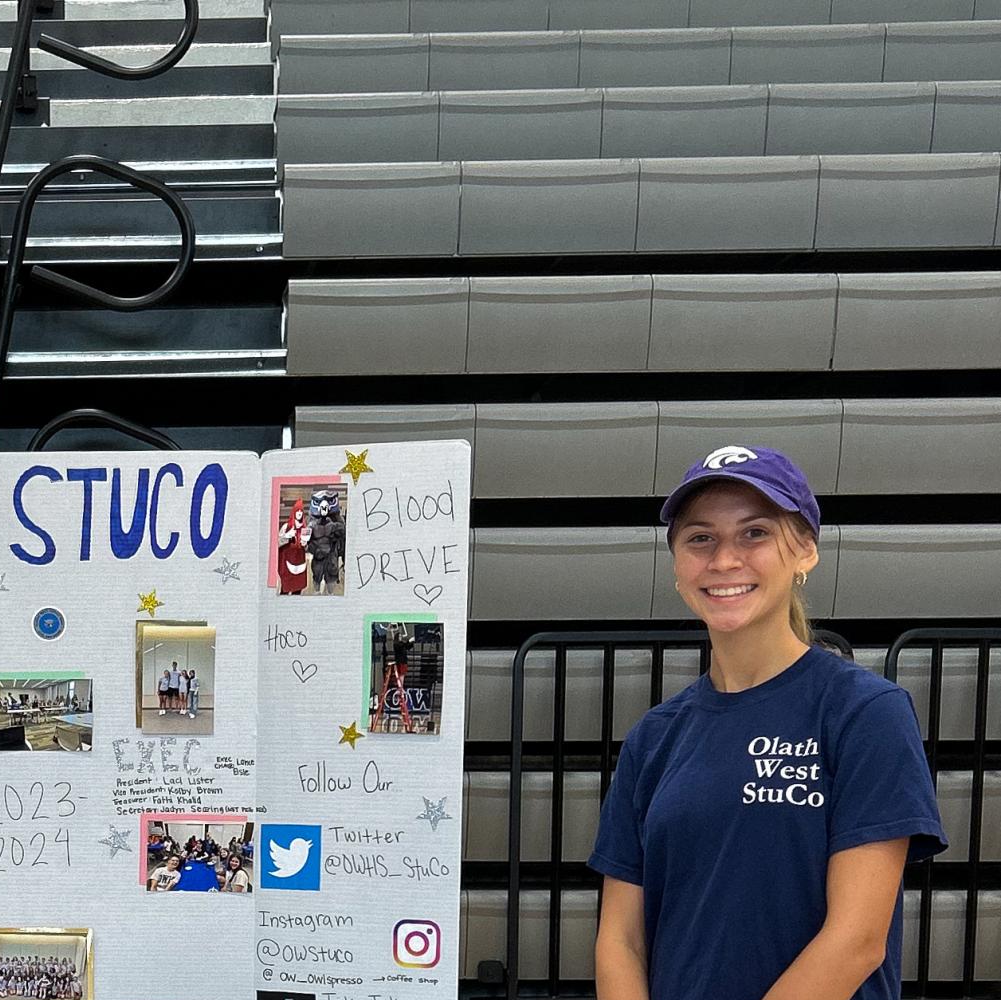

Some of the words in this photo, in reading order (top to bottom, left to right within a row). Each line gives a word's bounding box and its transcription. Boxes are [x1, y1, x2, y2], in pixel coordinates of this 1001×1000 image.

[9, 462, 229, 566] STUCO
[362, 480, 455, 532] Blood
[356, 543, 461, 590] DRIVE
[112, 737, 201, 775] EXEC
[747, 735, 819, 757] Olath
[298, 764, 352, 793] Follow
[363, 760, 394, 793] Our
[754, 757, 820, 781] West
[742, 782, 825, 808] StuCo
[328, 826, 405, 844] Twitter
[258, 910, 354, 933] Instagram
